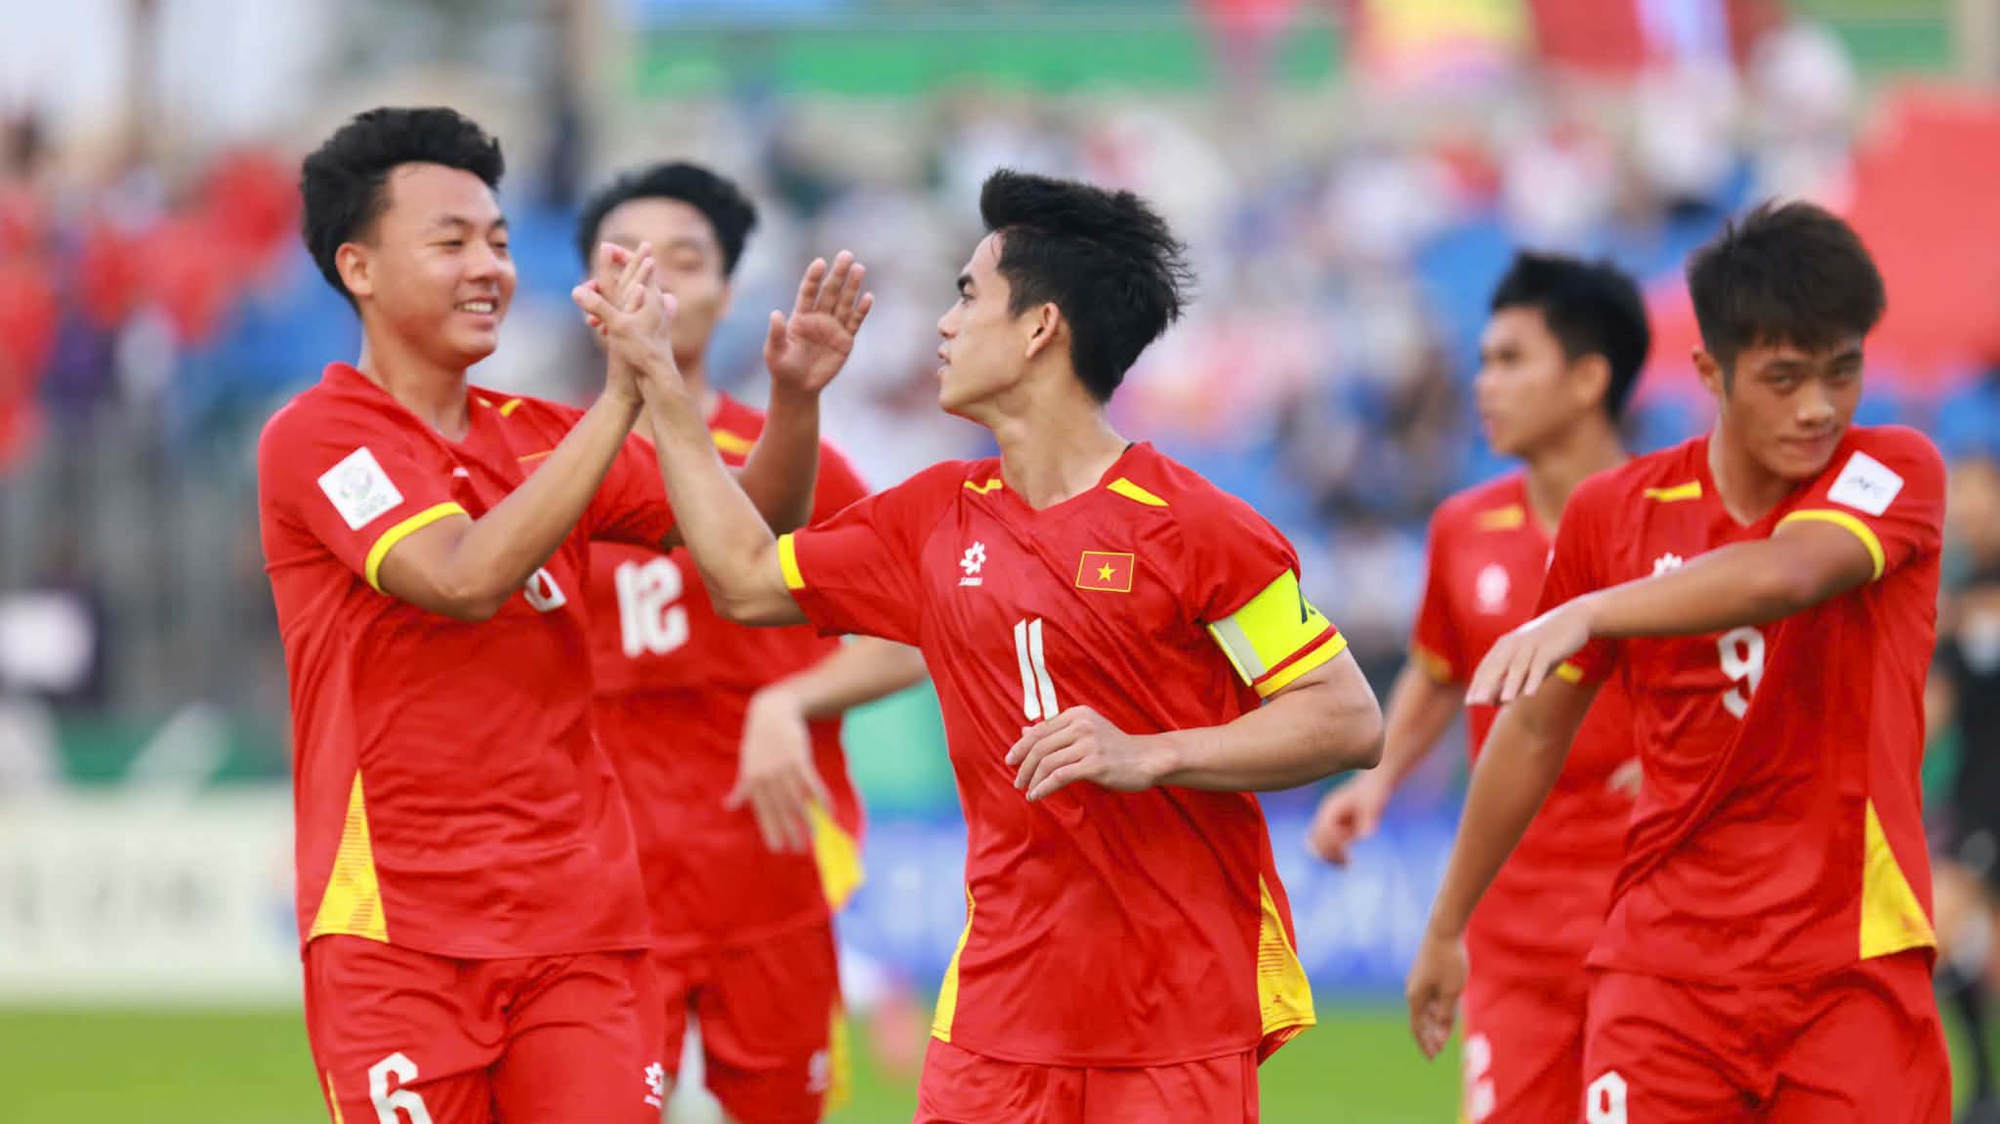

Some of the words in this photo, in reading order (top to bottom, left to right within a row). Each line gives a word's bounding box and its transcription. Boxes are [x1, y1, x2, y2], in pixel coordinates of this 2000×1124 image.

[615, 556, 689, 658] 12
[1014, 617, 1059, 721] 11
[1717, 626, 1765, 719] 9
[368, 1051, 434, 1124] 6
